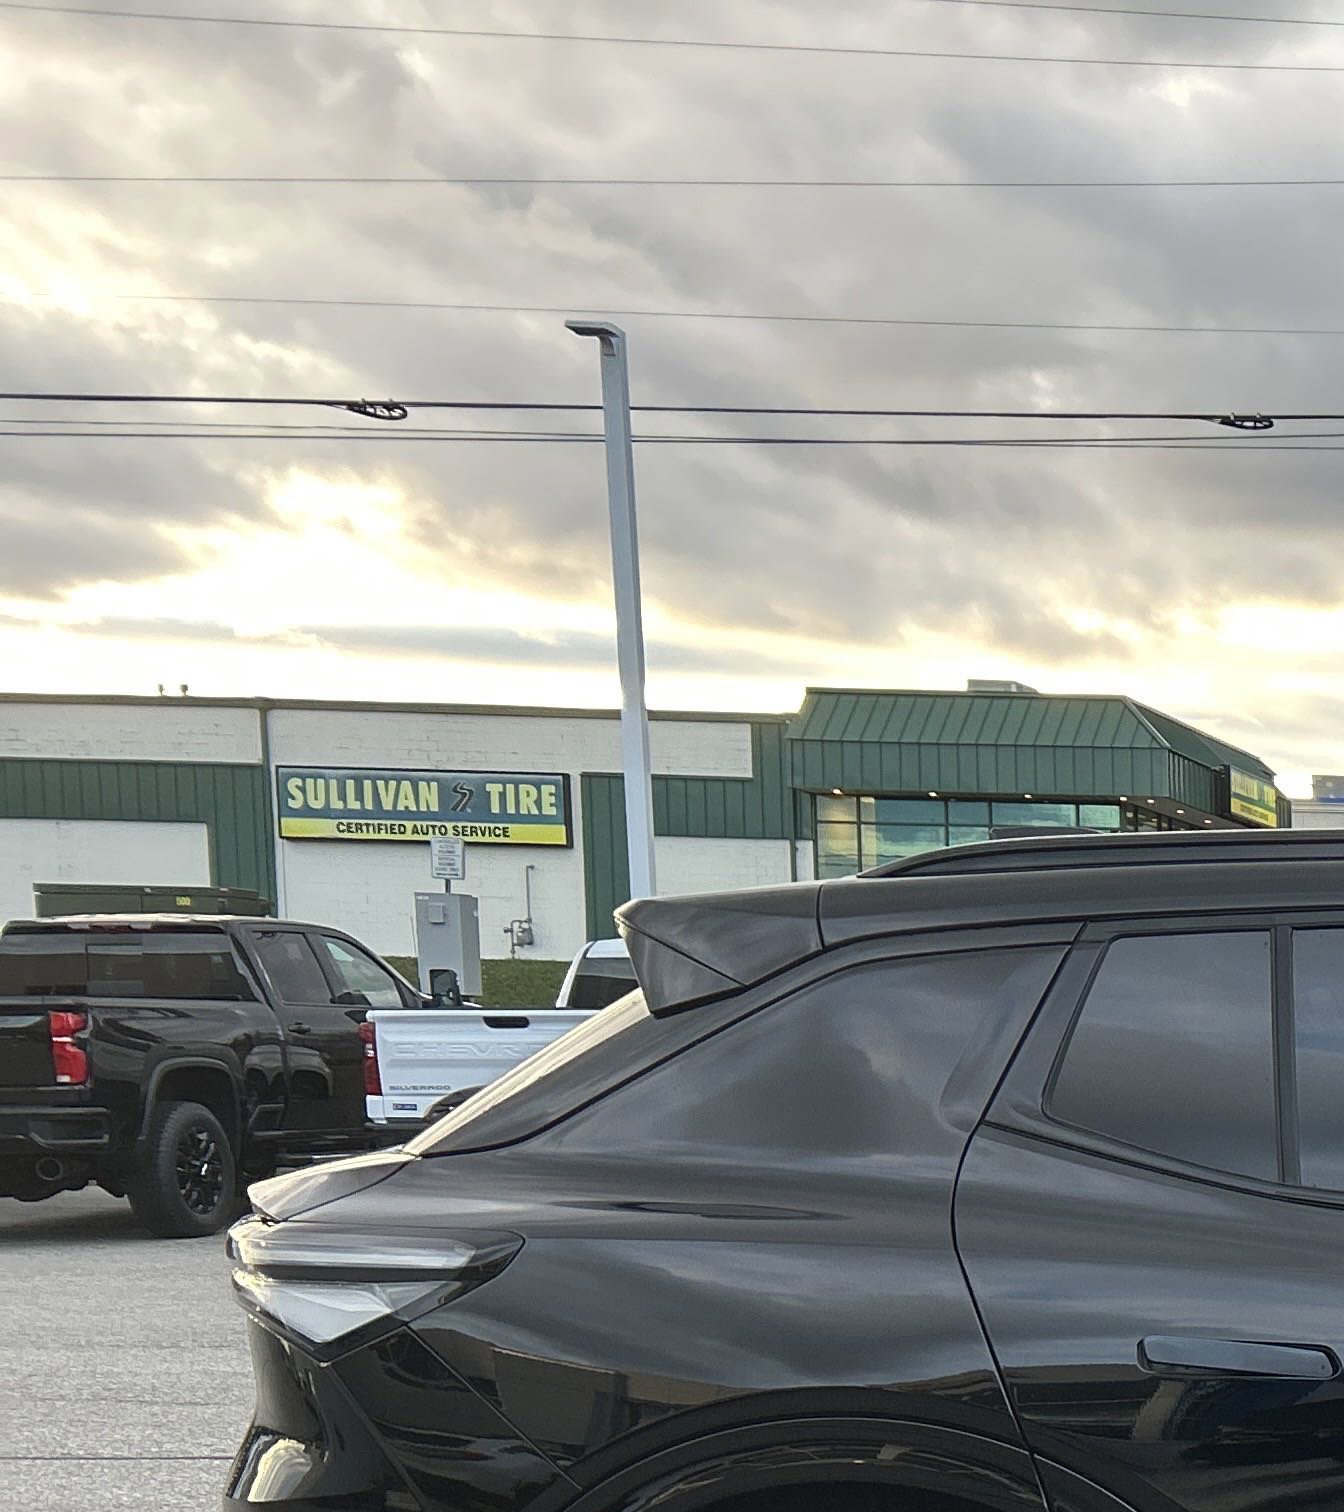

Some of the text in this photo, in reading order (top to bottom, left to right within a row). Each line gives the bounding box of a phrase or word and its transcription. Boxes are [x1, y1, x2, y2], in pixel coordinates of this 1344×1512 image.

[286, 776, 558, 816] SULLIVAN TIRE
[335, 820, 510, 839] CERTIFIED AUTO SERVICE
